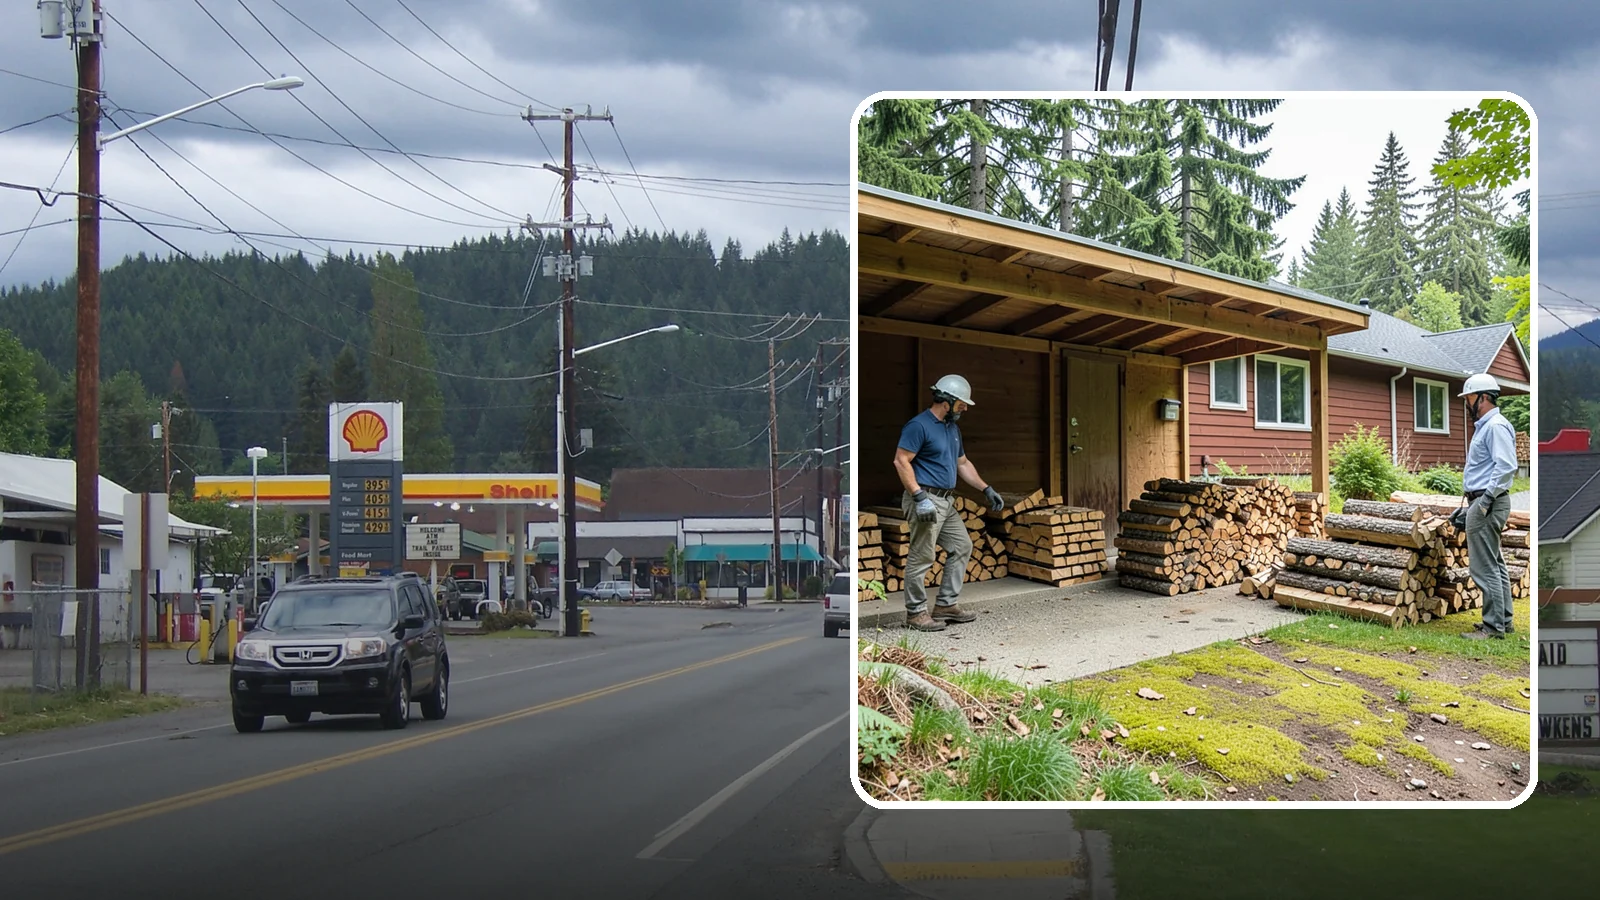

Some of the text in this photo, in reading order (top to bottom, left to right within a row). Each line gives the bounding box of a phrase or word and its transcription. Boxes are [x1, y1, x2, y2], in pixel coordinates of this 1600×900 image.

[365, 479, 383, 490] 395
[490, 484, 547, 499] Shell
[365, 494, 383, 504] 405
[365, 508, 383, 518] 415
[365, 522, 383, 532] 429
[1538, 643, 1567, 666] AID
